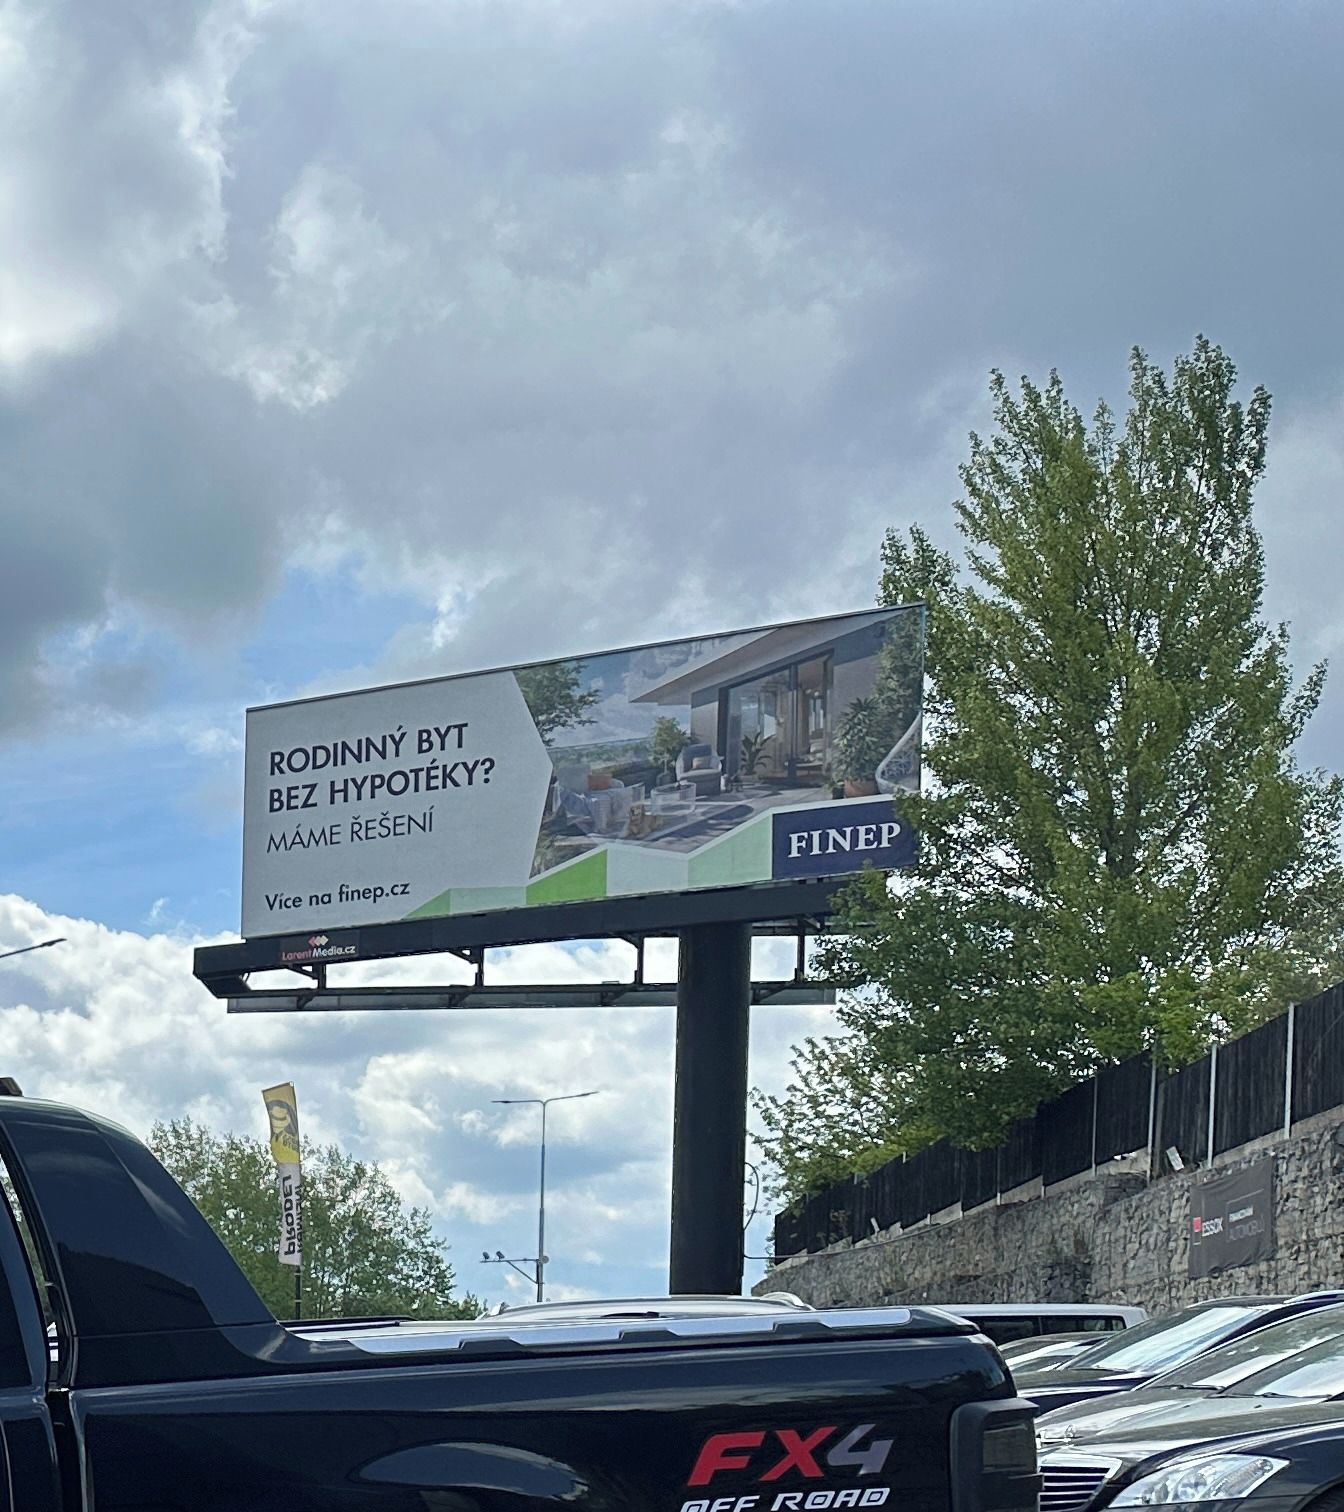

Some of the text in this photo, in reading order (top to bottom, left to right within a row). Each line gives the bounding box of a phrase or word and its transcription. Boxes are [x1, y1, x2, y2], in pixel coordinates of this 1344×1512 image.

[269, 722, 468, 776] RODINNÝ BYT
[269, 757, 495, 813] BEZ HYPOTÉKY?
[267, 805, 435, 854] MÁME ŘEŠENÍ
[787, 822, 901, 858] FINEP
[265, 883, 410, 911] Více na finep.cz
[282, 945, 356, 961] LarentMedia.cz
[687, 1424, 894, 1487] FX4
[770, 1487, 890, 1512] ROAD
